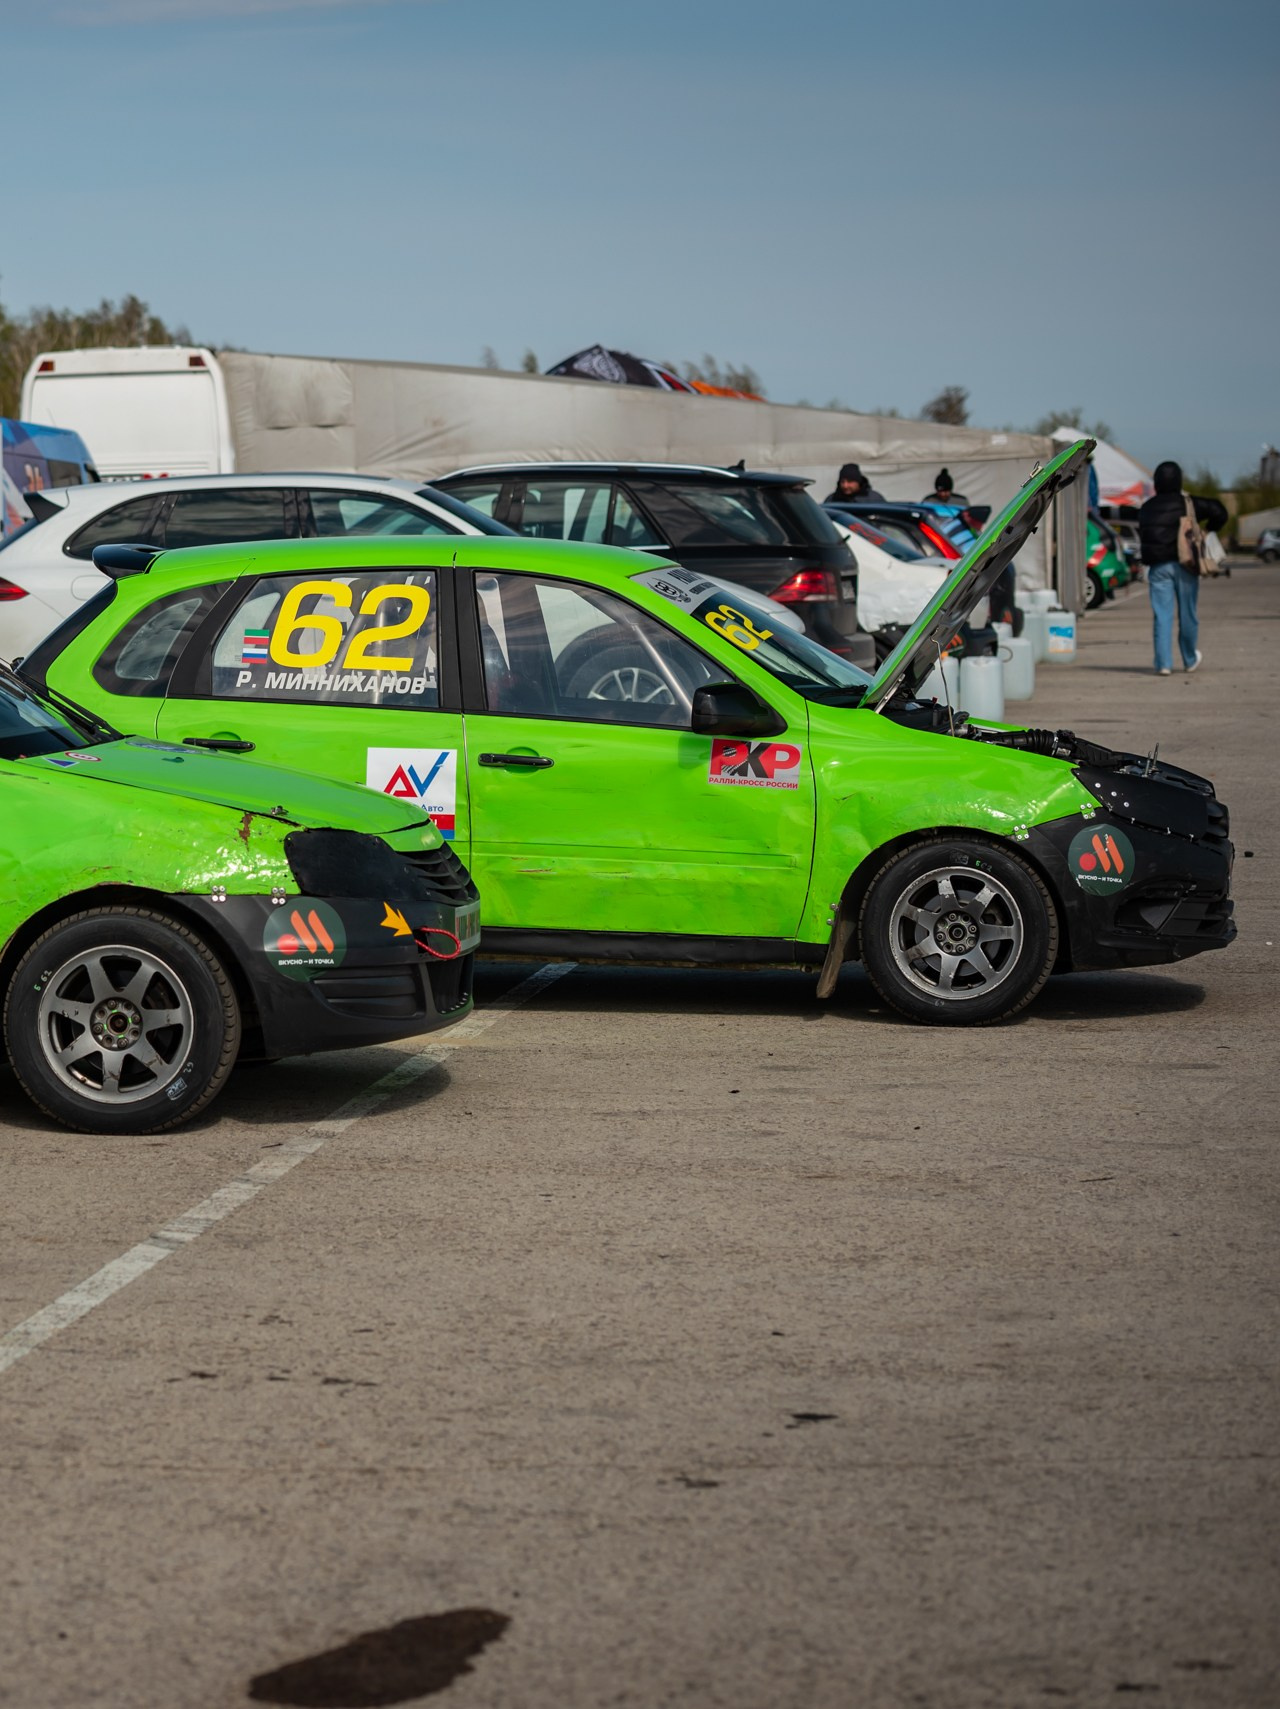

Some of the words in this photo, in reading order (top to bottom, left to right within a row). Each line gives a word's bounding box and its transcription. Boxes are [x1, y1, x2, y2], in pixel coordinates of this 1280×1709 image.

[270, 580, 430, 672] 62
[705, 604, 774, 650] 62
[236, 670, 257, 688] Р.
[264, 672, 426, 695] МИННИХАНОВ
[708, 777, 764, 787] РАЛЛИ-КРОСС
[766, 780, 798, 789] РОССИИ
